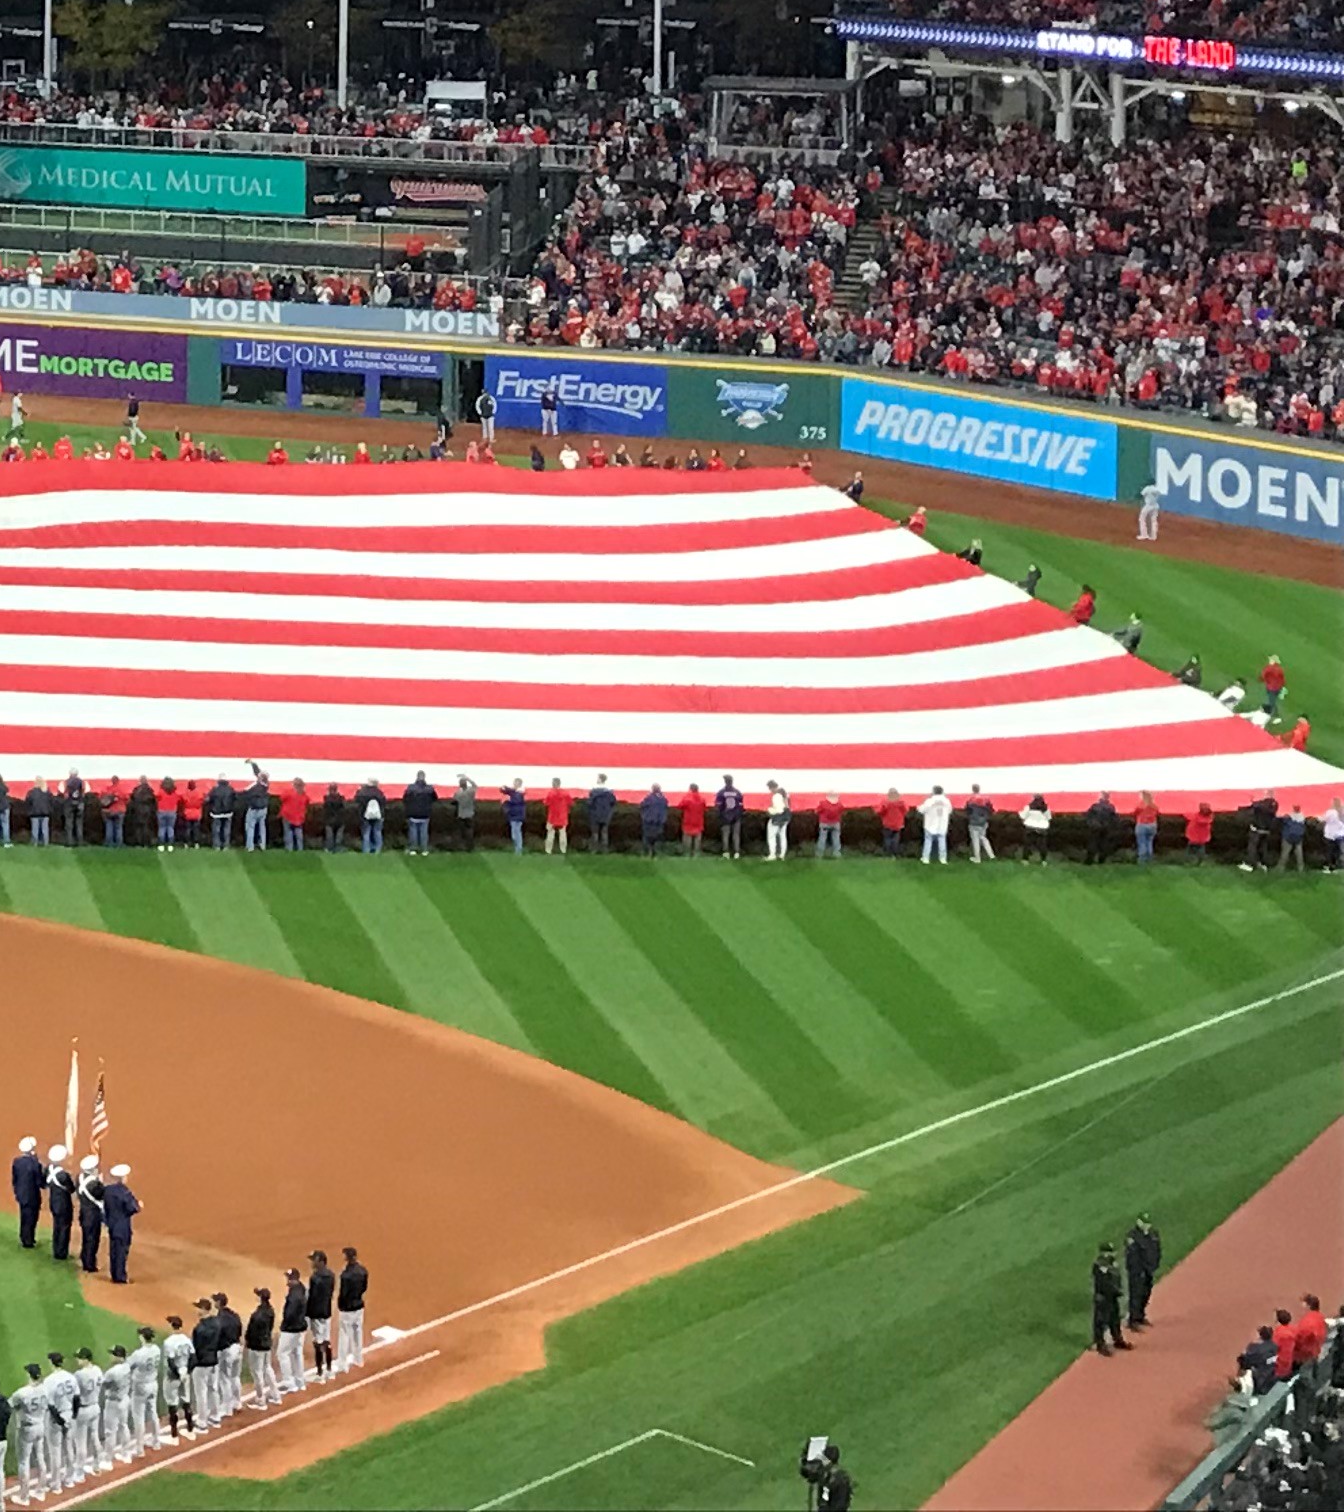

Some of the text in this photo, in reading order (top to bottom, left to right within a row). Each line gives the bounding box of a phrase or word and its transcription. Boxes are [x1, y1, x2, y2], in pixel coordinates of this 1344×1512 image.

[1037, 31, 1236, 72] STAND FOR THE LAND
[38, 163, 277, 198] MEDICAL MUTUAL
[190, 298, 281, 323] MOEN
[404, 309, 499, 336] MOEN
[40, 355, 174, 382] MORTGAGE
[497, 370, 662, 411] FirstEnergy
[799, 425, 827, 440] 375
[855, 401, 1096, 476] PROGRESSIVE
[1155, 447, 1344, 527] MOEN
